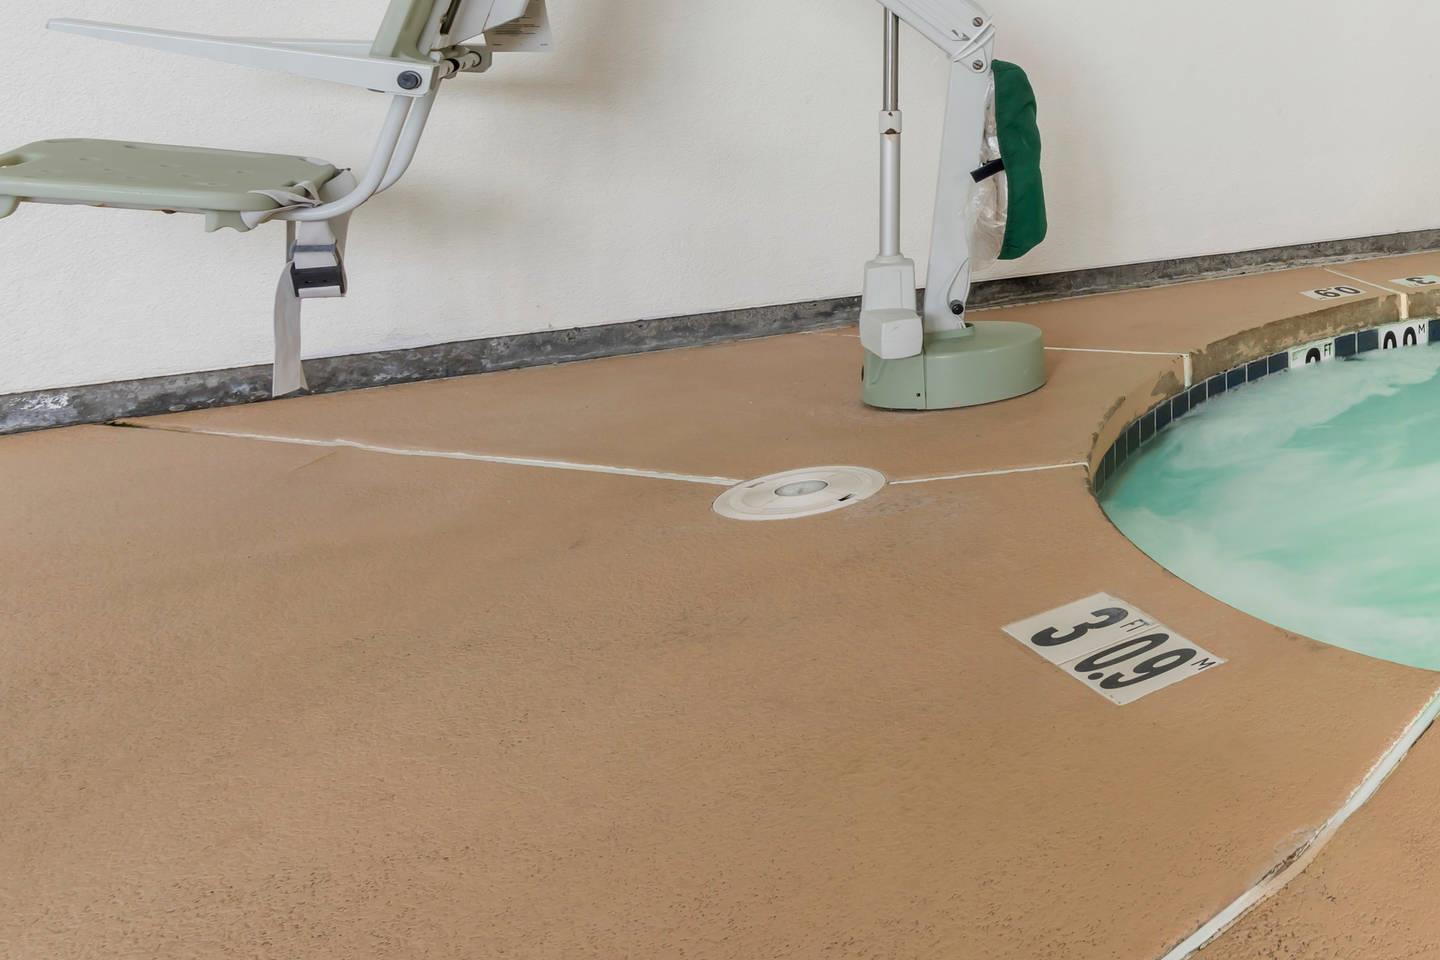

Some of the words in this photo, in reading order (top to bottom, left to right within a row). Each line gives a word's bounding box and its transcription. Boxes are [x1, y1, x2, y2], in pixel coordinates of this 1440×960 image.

[1324, 343, 1332, 356] FT
[1031, 607, 1128, 646] 3
[1120, 619, 1150, 632] FT
[1192, 657, 1216, 670] M
